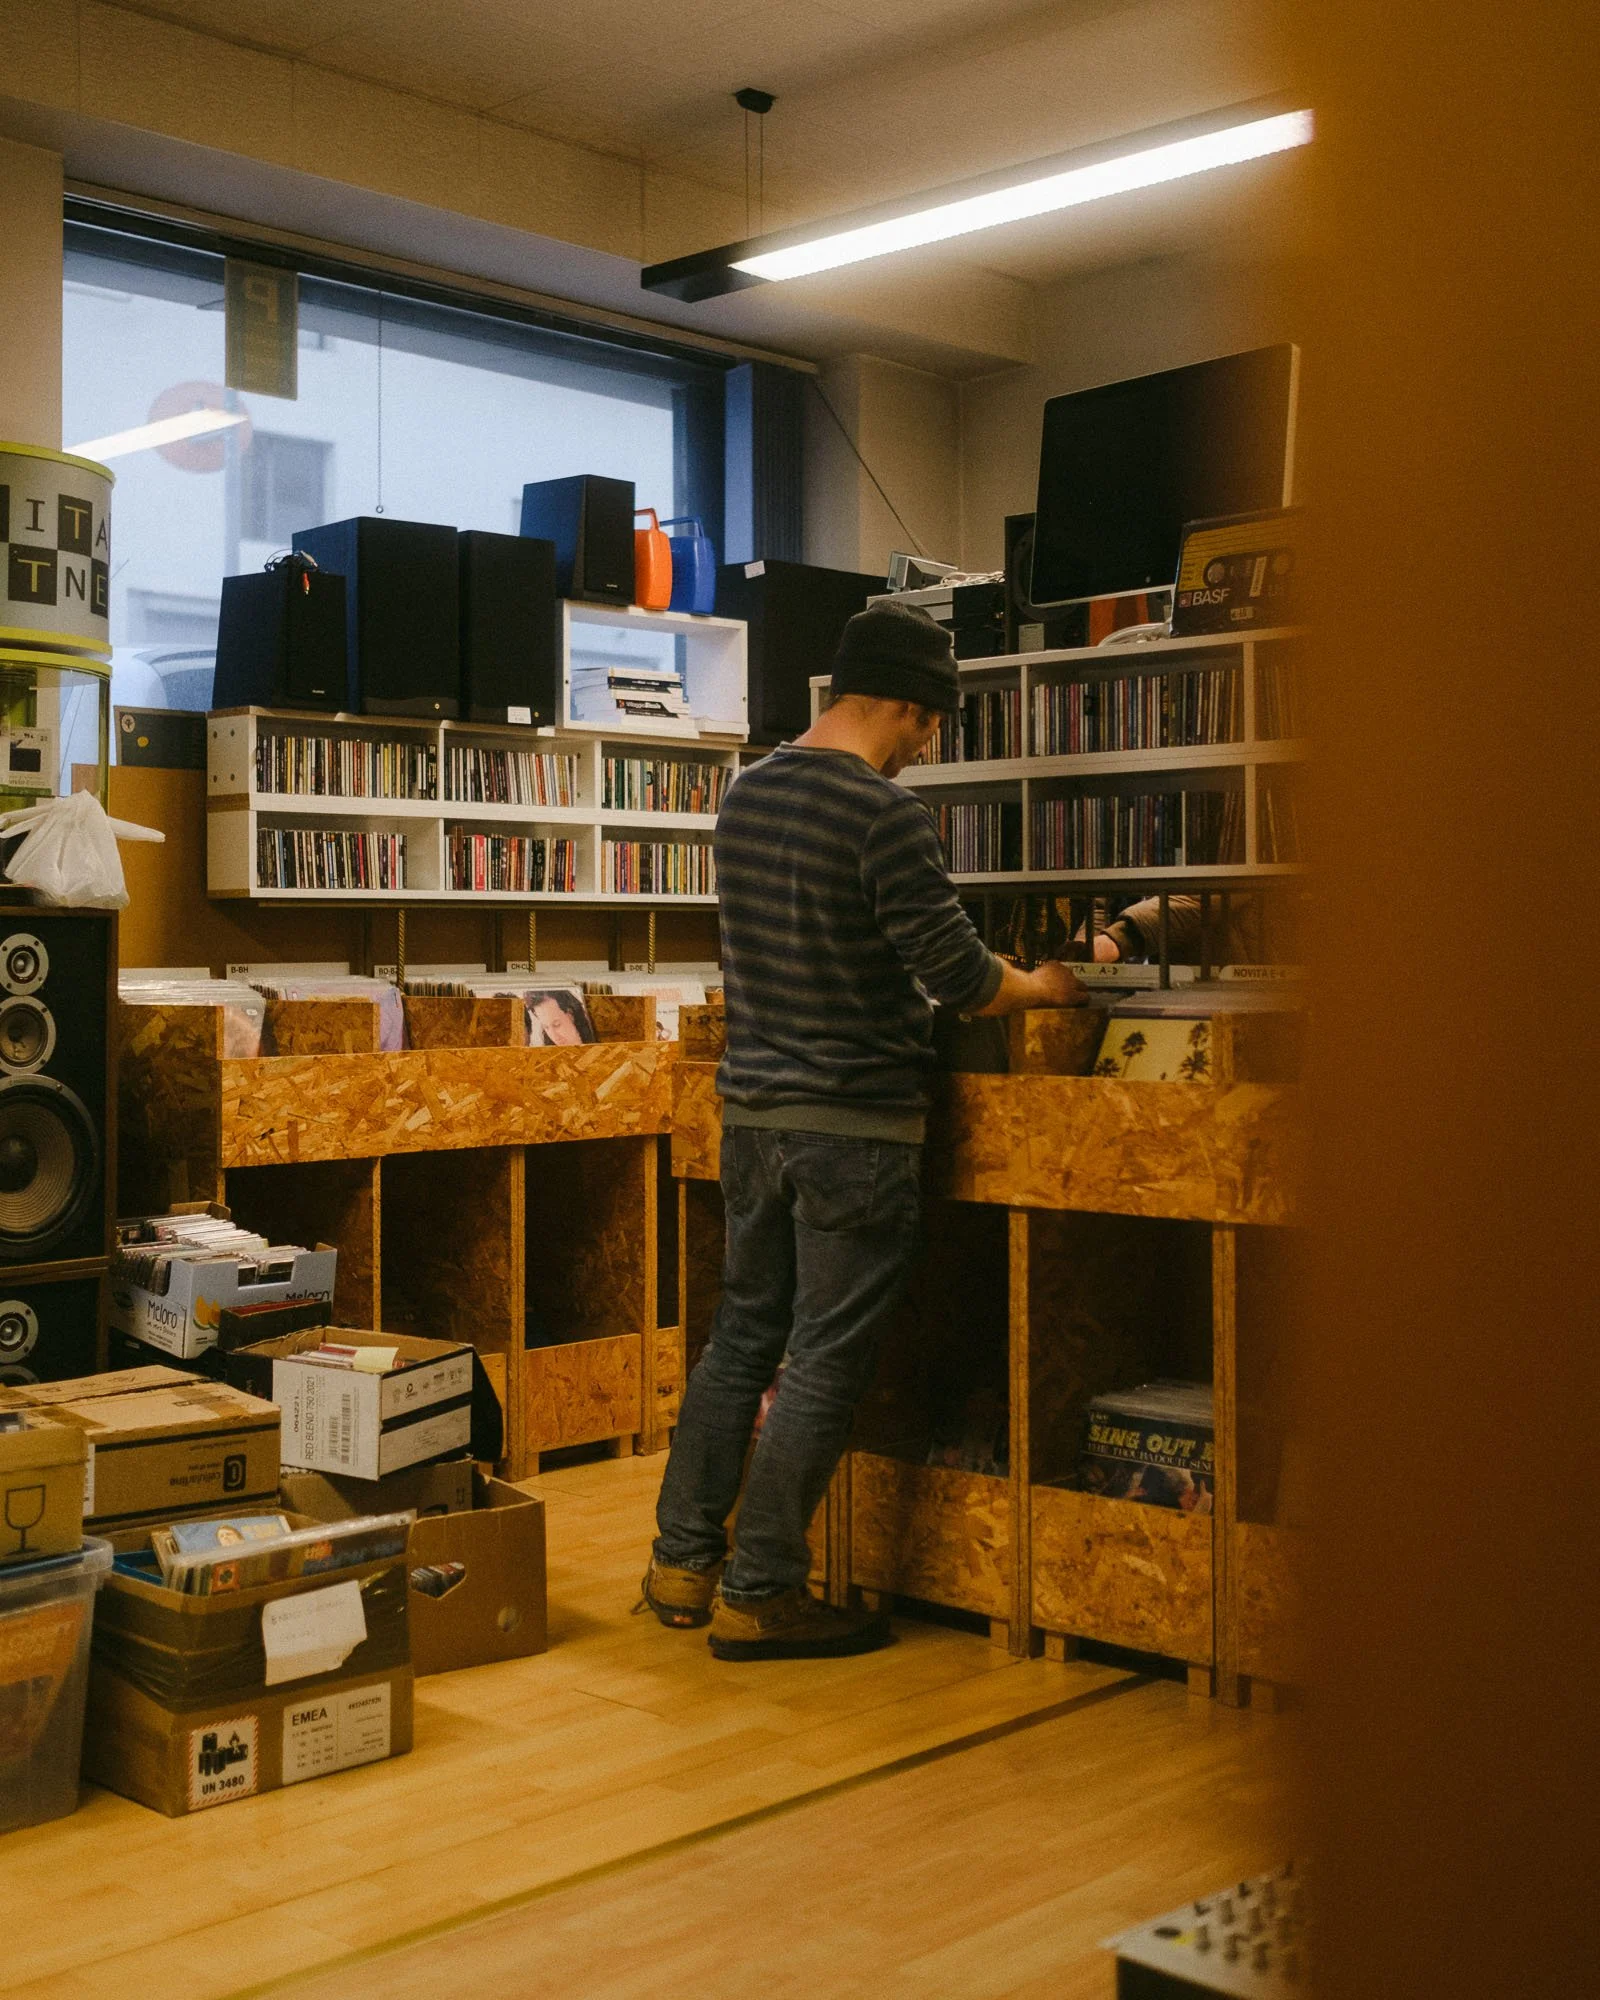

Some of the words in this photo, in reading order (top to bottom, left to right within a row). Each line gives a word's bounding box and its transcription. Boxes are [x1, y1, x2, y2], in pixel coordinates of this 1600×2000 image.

[1192, 588, 1230, 606] BASF
[231, 966, 249, 974] B-BH
[1099, 966, 1118, 975] A-D
[147, 1300, 178, 1329] Meloro
[306, 1376, 314, 1395] 2021
[305, 1413, 314, 1441] BLEND
[1088, 1424, 1141, 1449] SING
[1146, 1433, 1197, 1457] OUT
[305, 1443, 314, 1460] RED
[292, 1707, 328, 1726] EMEA
[202, 1782, 216, 1795] UN
[219, 1774, 245, 1791] 3480
